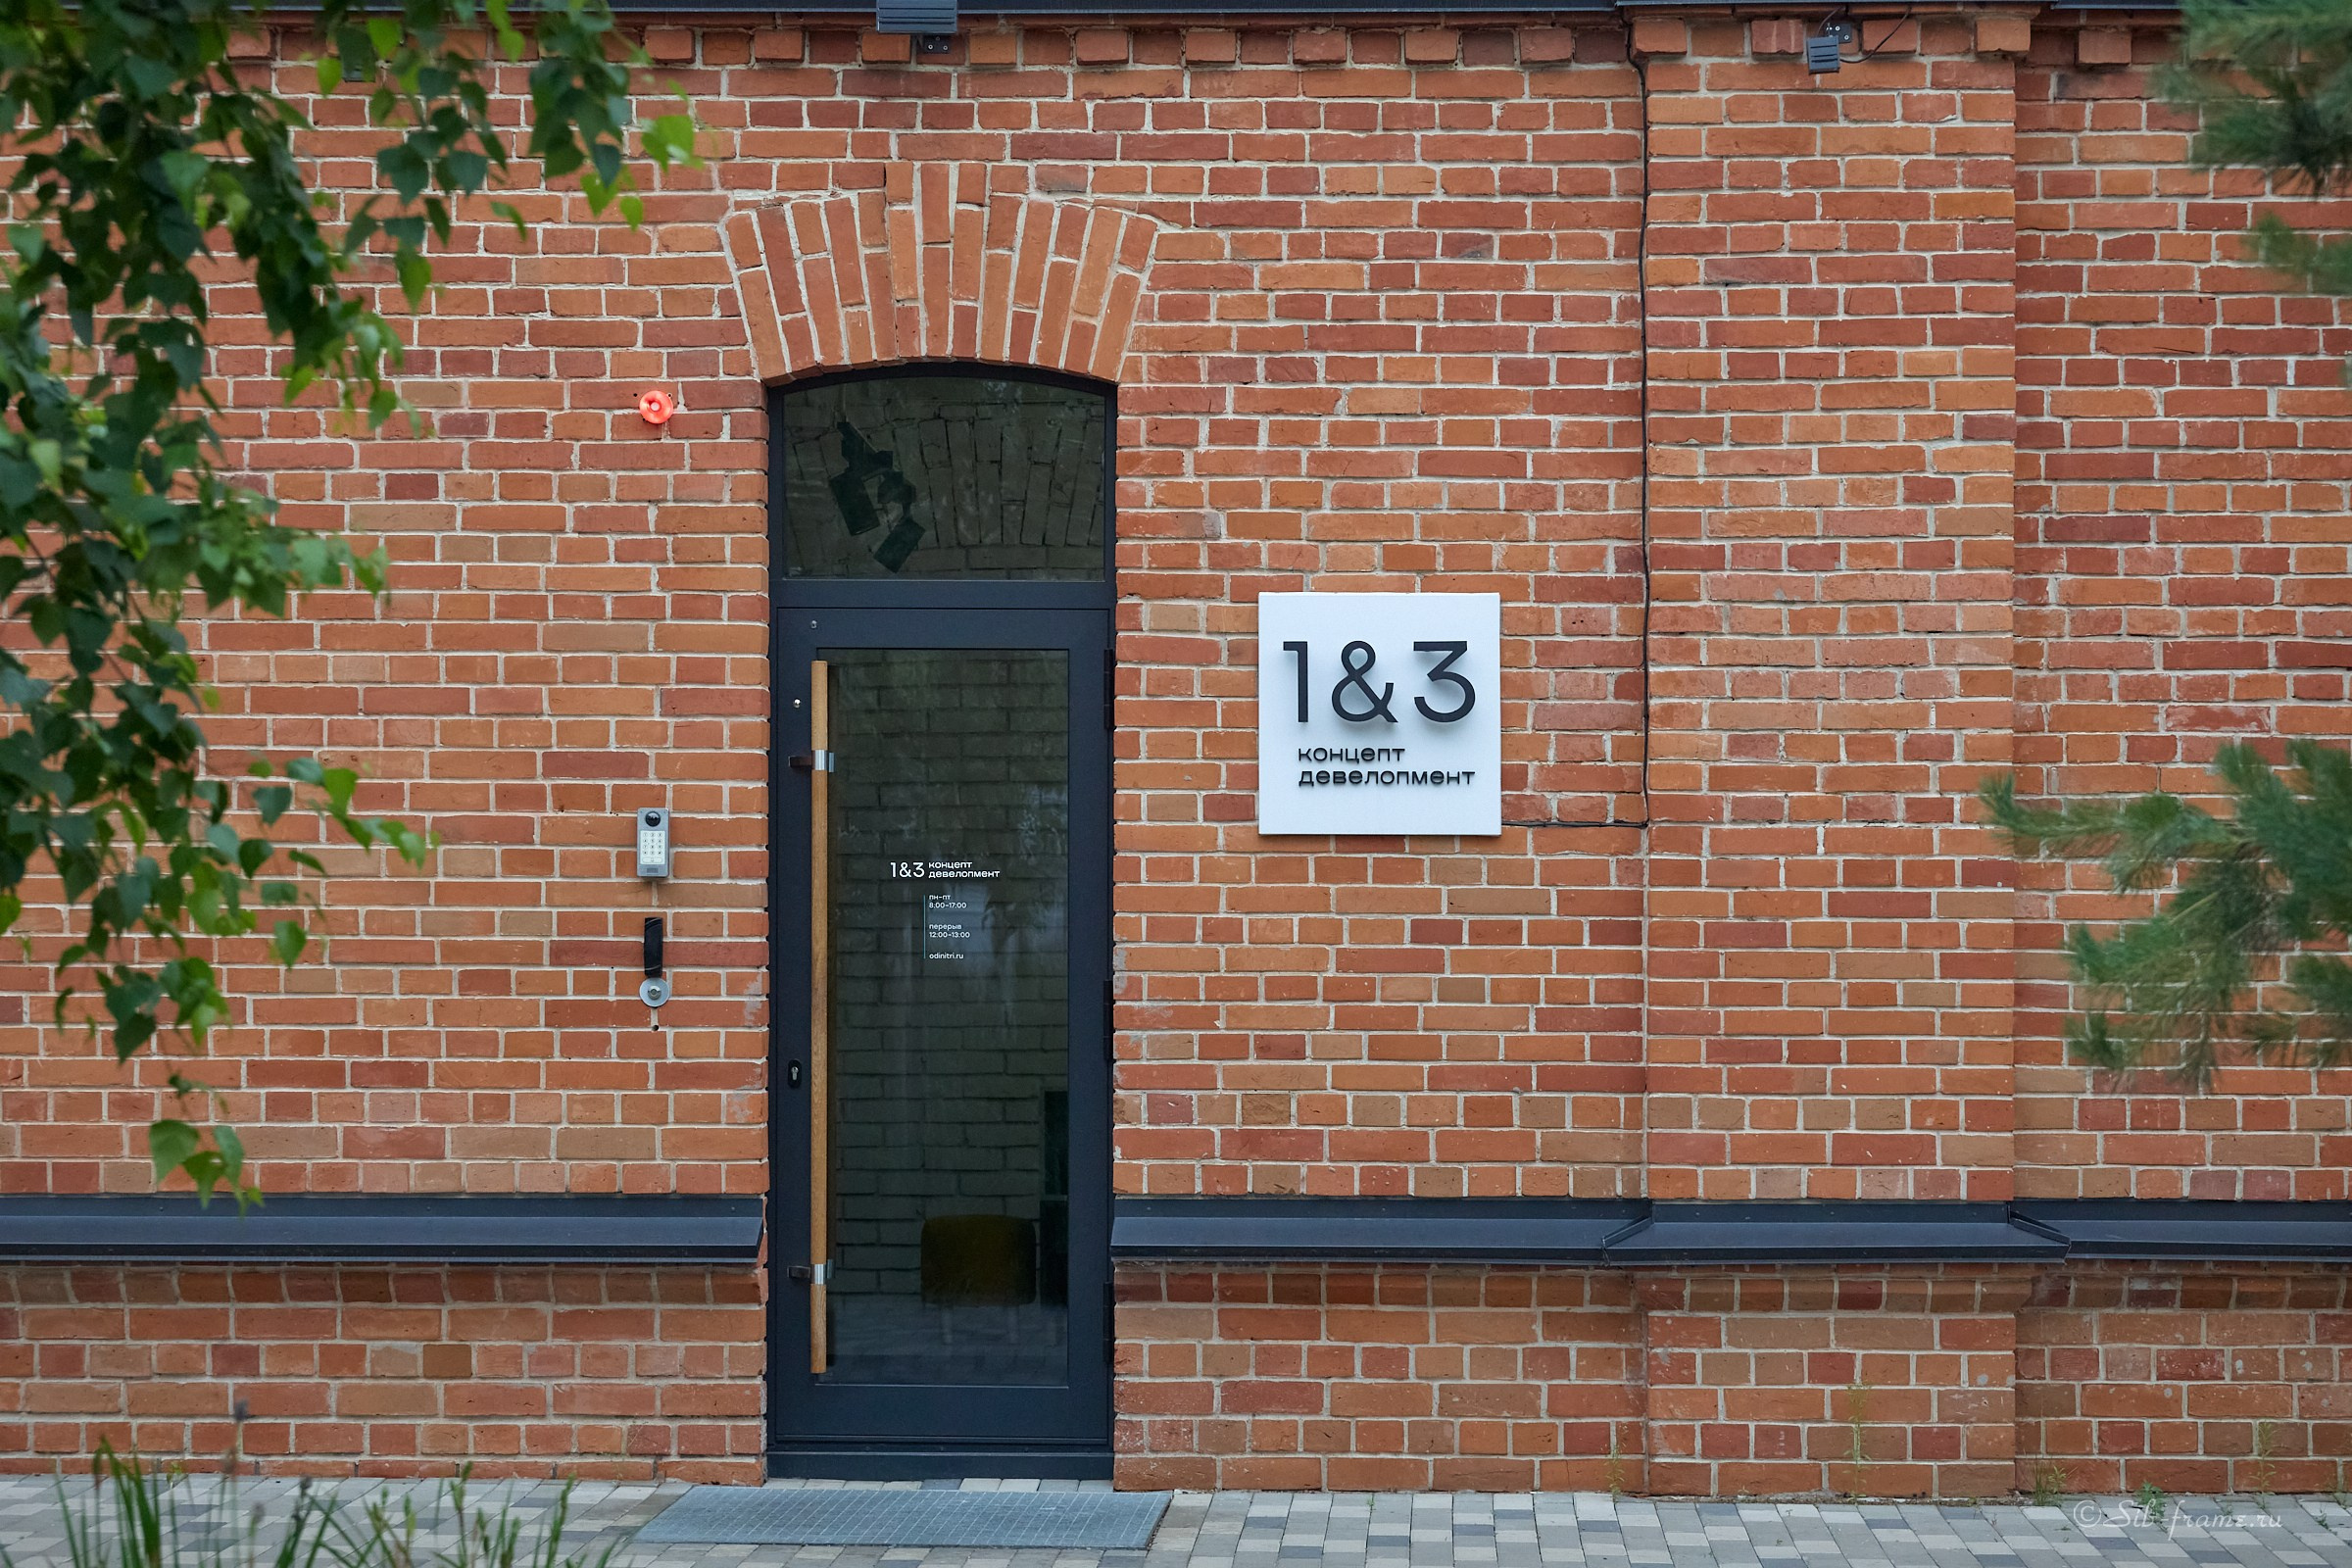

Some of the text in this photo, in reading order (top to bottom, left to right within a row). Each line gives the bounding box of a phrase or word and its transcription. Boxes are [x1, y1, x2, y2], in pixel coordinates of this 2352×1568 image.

[1283, 640, 1476, 723] 1&3
[1298, 747, 1405, 764] концепт
[1298, 770, 1476, 787] девелопмент
[890, 861, 925, 878] 1&3
[928, 870, 1001, 879] девелопмент
